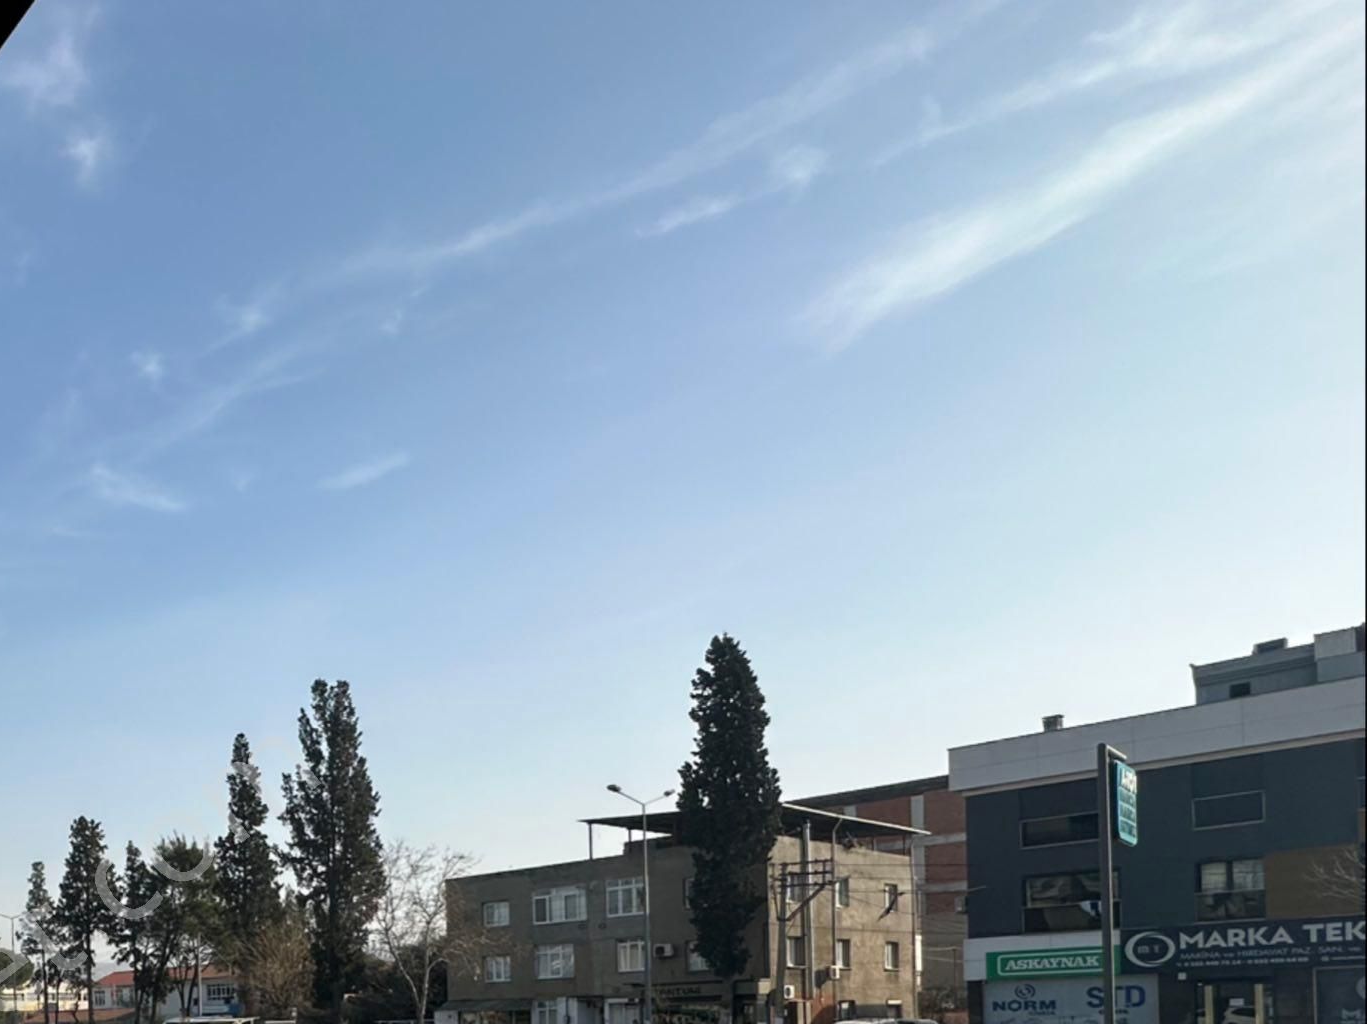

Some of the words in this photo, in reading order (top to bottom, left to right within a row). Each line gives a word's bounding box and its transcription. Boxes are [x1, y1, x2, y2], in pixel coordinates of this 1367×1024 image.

[1179, 925, 1294, 949] MARKA
[1302, 921, 1366, 943] TEK
[1005, 955, 1100, 971] ASKAYNAK
[992, 999, 1057, 1012] NORM
